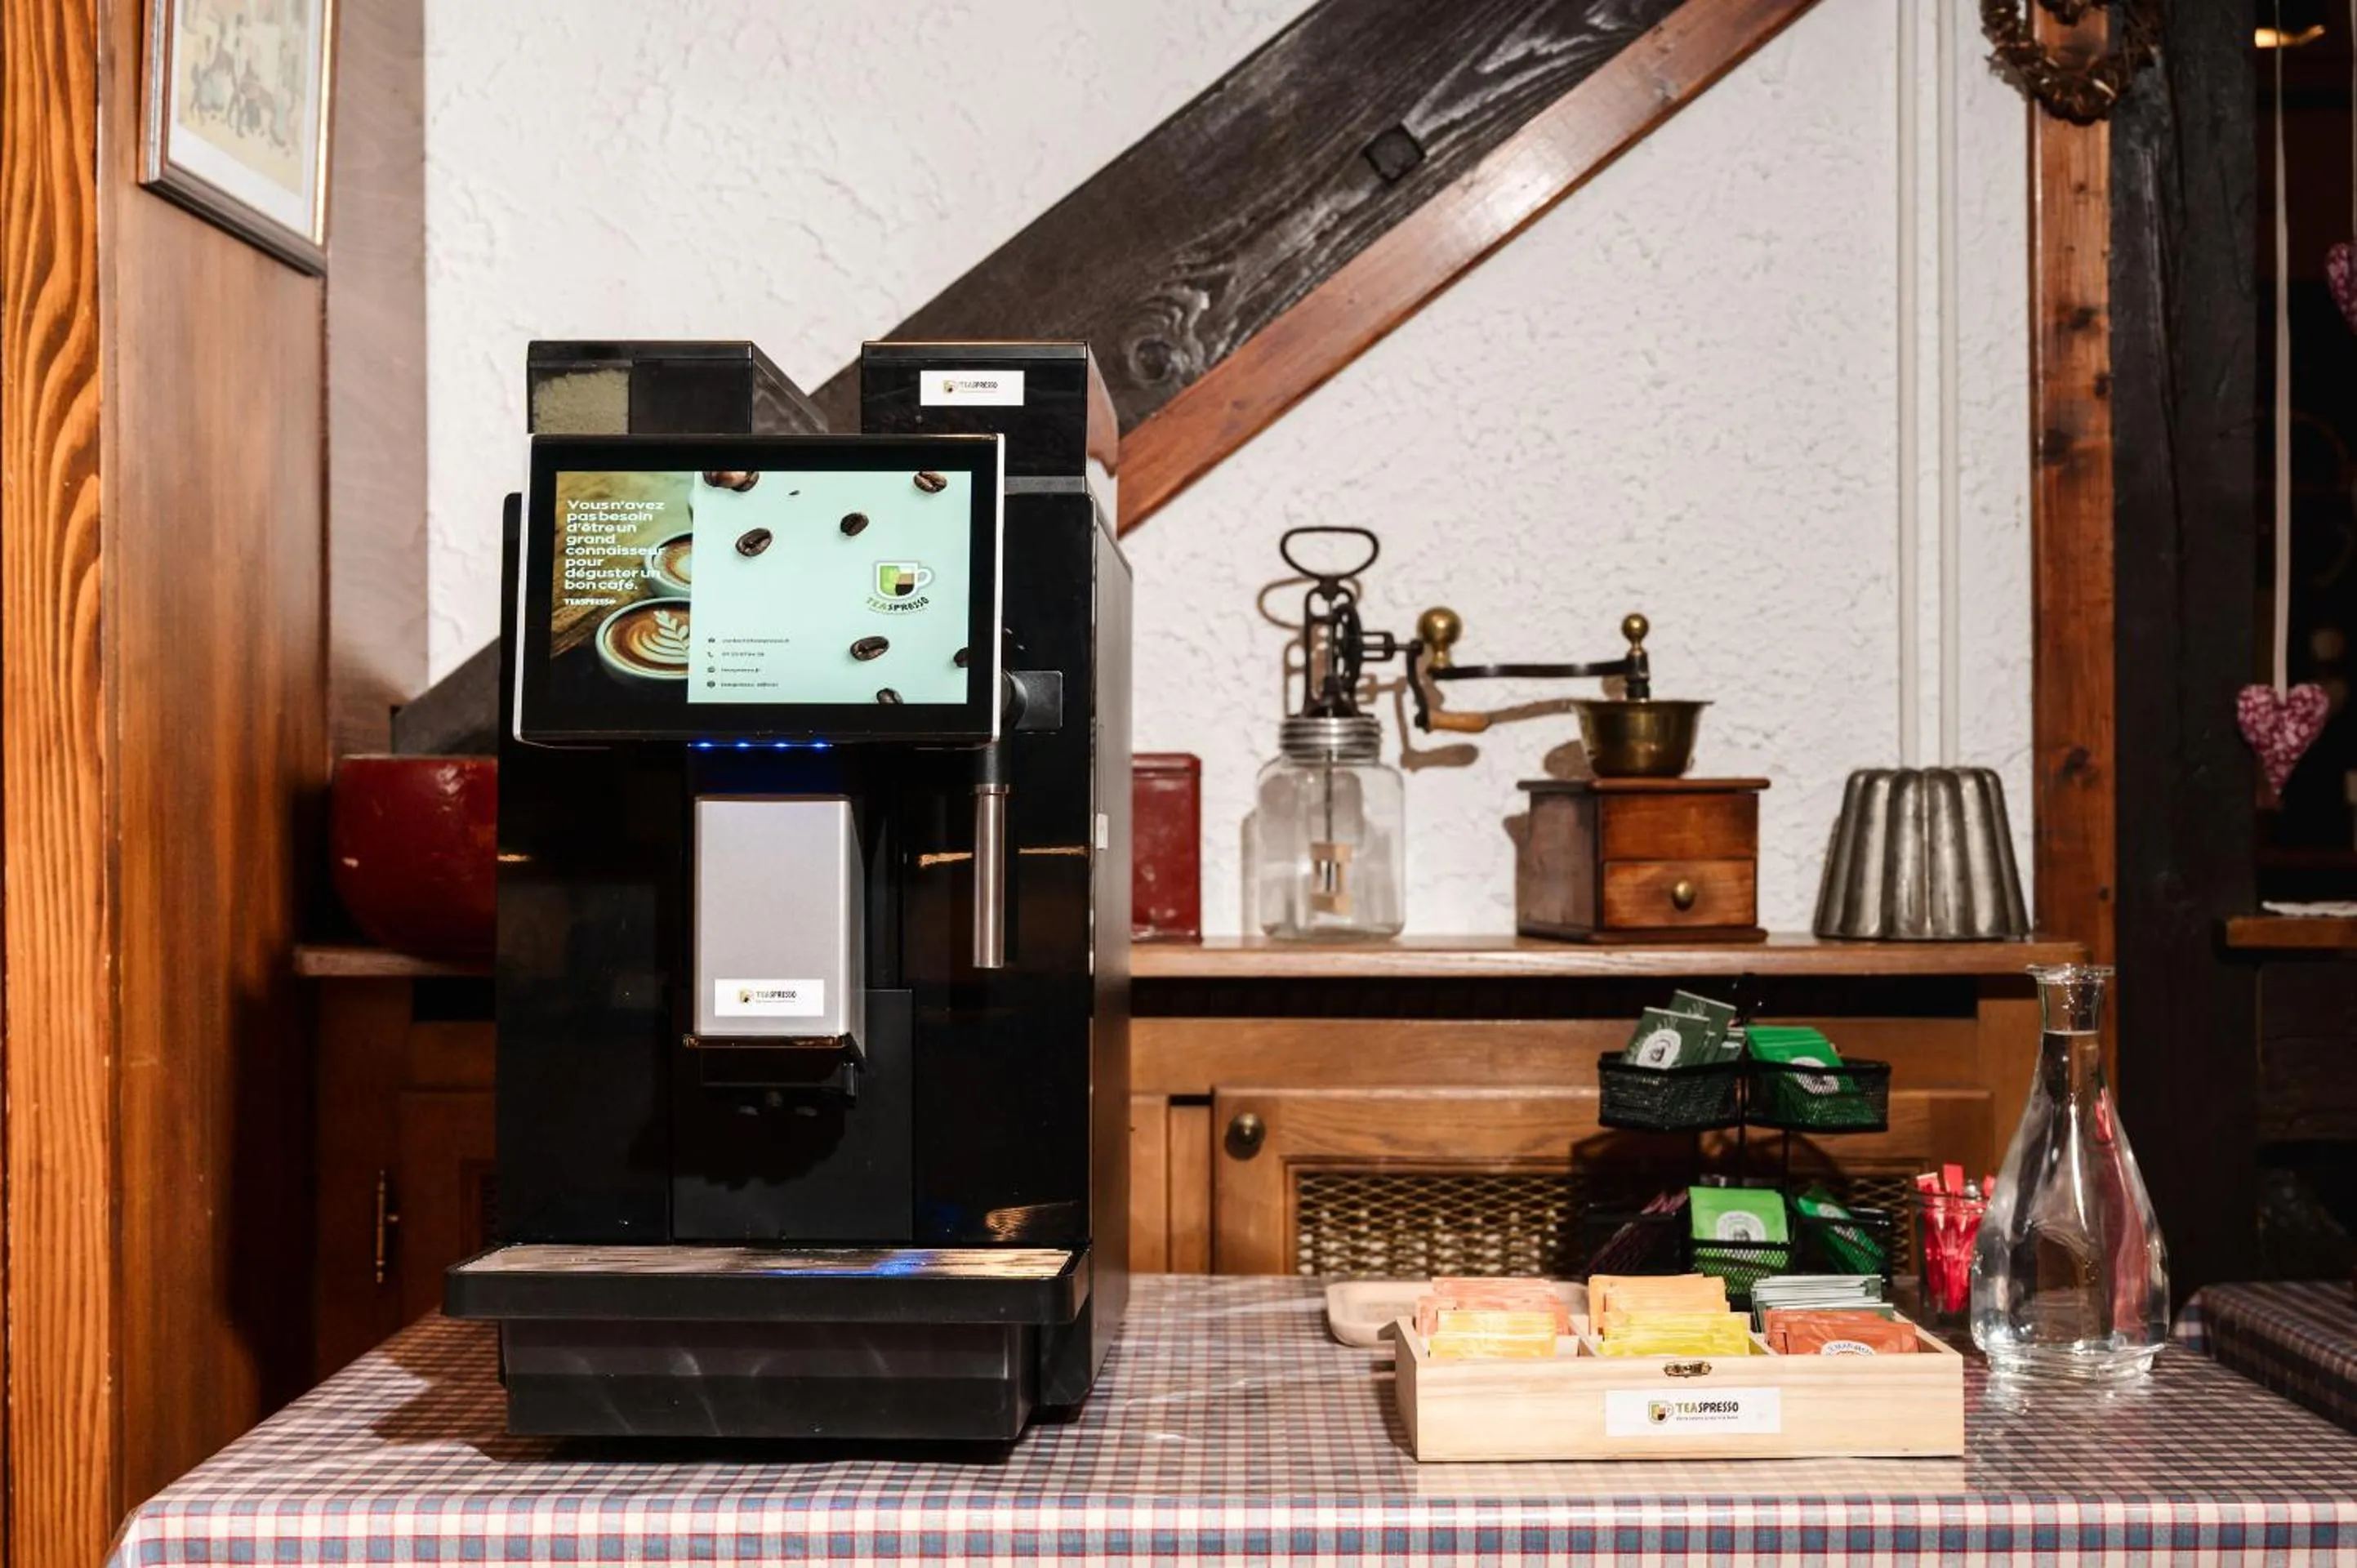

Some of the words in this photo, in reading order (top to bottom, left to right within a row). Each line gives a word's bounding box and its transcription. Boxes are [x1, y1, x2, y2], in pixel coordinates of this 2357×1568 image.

[568, 500, 609, 510] Vous
[610, 500, 666, 510] n'avez
[566, 512, 597, 523] pas
[598, 510, 653, 522] besoin
[566, 522, 615, 533] d'être
[617, 523, 637, 533] un
[565, 533, 616, 546] grand
[565, 545, 666, 555] connaisseur
[565, 558, 604, 568] pour
[564, 568, 639, 581] déguster
[639, 569, 661, 578] un
[564, 579, 596, 590] bon
[597, 578, 639, 591] café.
[866, 596, 929, 611] TEASPRESSO
[1675, 1401, 1739, 1414] TEASPRESSO
